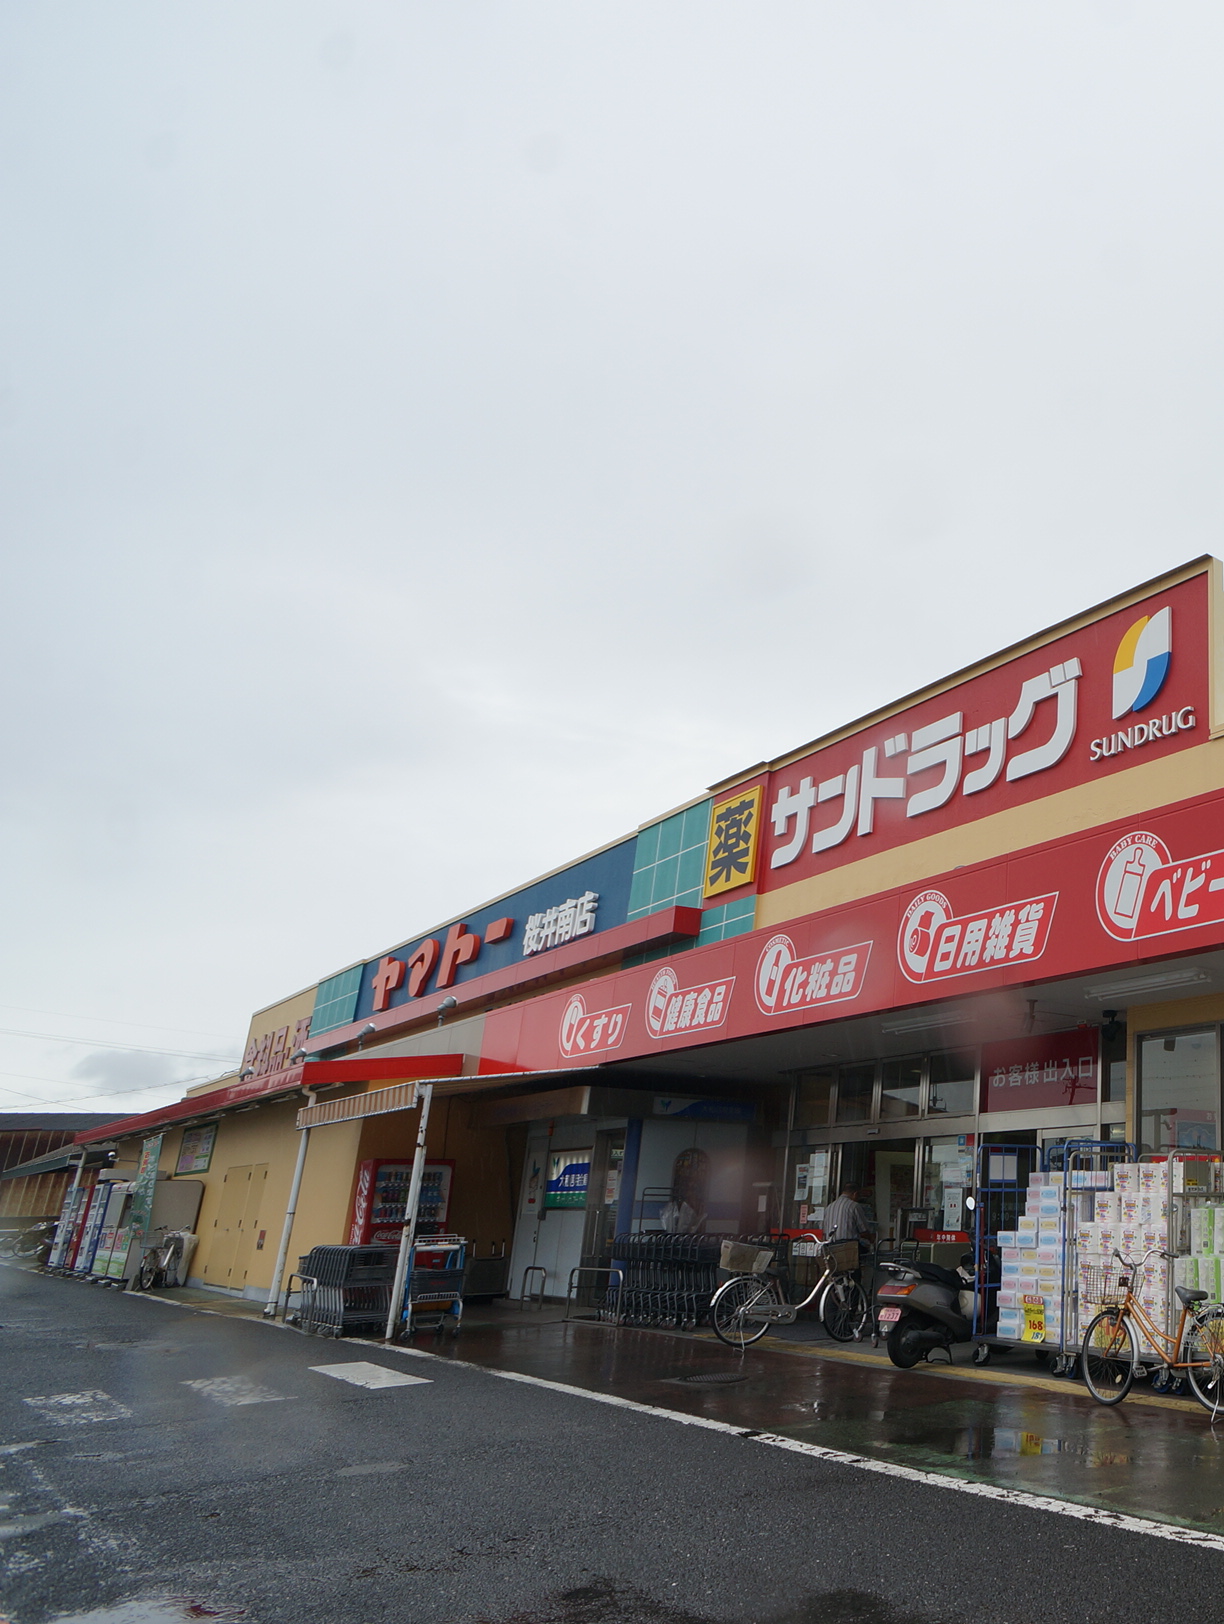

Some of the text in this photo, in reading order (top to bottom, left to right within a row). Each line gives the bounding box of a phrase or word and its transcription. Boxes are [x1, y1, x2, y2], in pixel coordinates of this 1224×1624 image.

[1090, 706, 1196, 761] SUNDRUG
[770, 657, 1082, 869] サンドラッグ
[708, 796, 755, 887] 薬
[1109, 835, 1159, 860] BABY CARE
[522, 890, 600, 957] 桜井南店
[907, 893, 948, 919] DAILY GOODS
[933, 902, 1045, 972] 日用雑貨
[372, 917, 515, 1012] ヤマトー
[783, 953, 857, 1006] 化粧品
[575, 1013, 622, 1049] くすり
[663, 985, 726, 1032] 健康食品
[992, 1056, 1094, 1088] お客様出入口
[1029, 1320, 1043, 1331] 168
